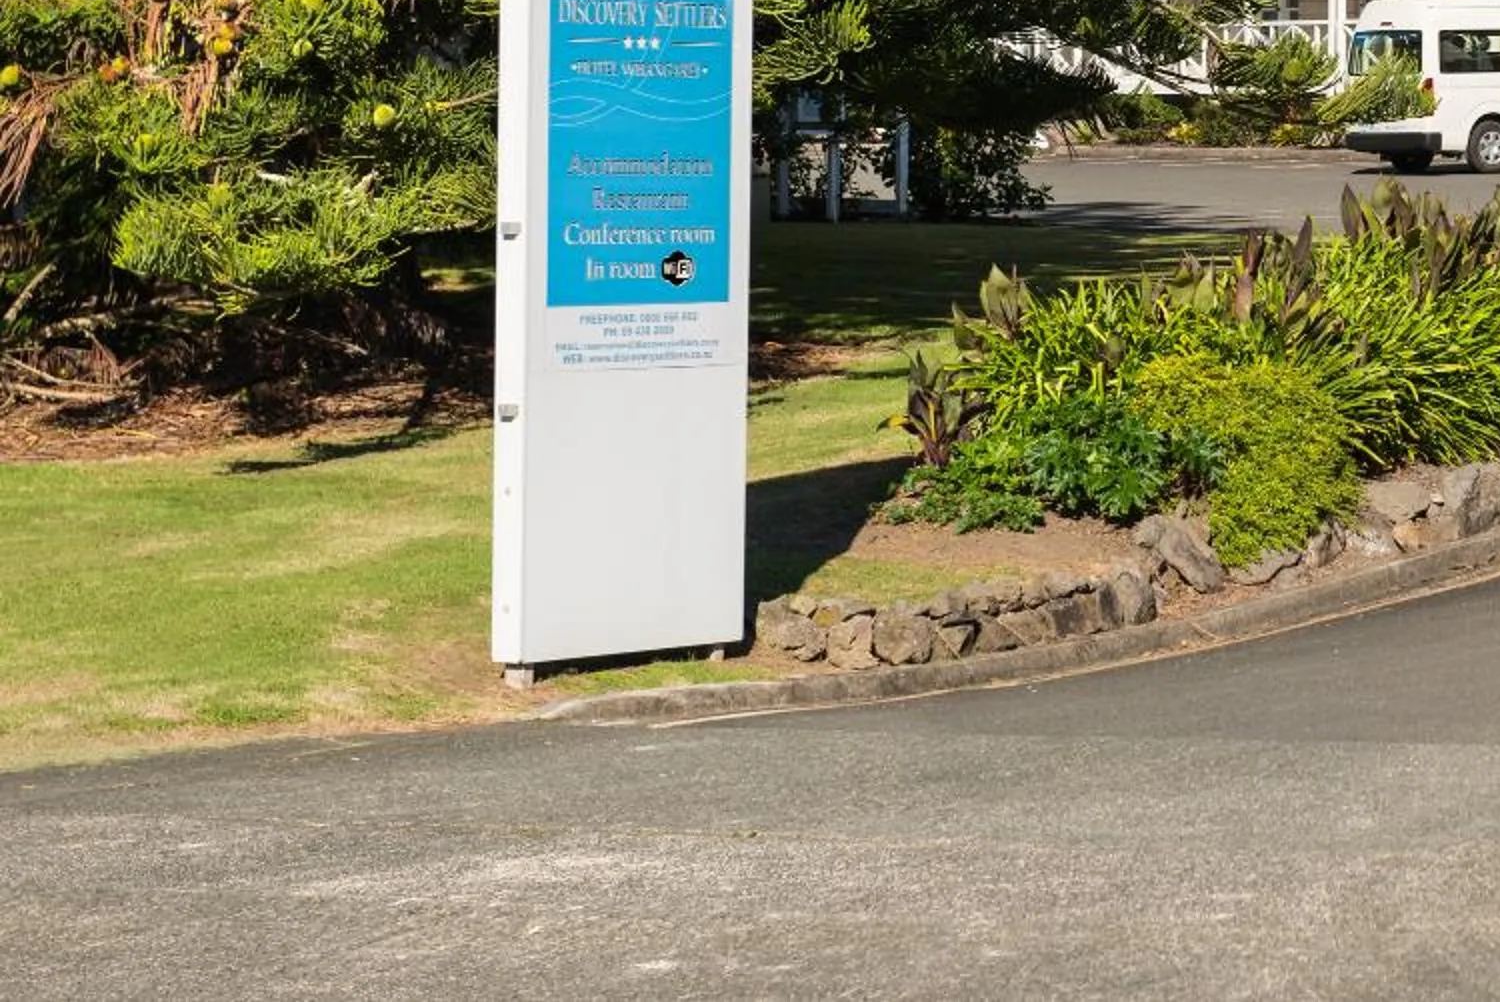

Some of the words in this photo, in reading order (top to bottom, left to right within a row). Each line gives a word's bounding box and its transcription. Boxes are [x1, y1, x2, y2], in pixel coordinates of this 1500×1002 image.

[567, 150, 713, 176] Accommodation
[592, 186, 689, 210] Restaurant
[564, 221, 666, 245] Conference
[671, 227, 715, 243] room
[586, 259, 604, 279] In
[609, 261, 656, 279] room
